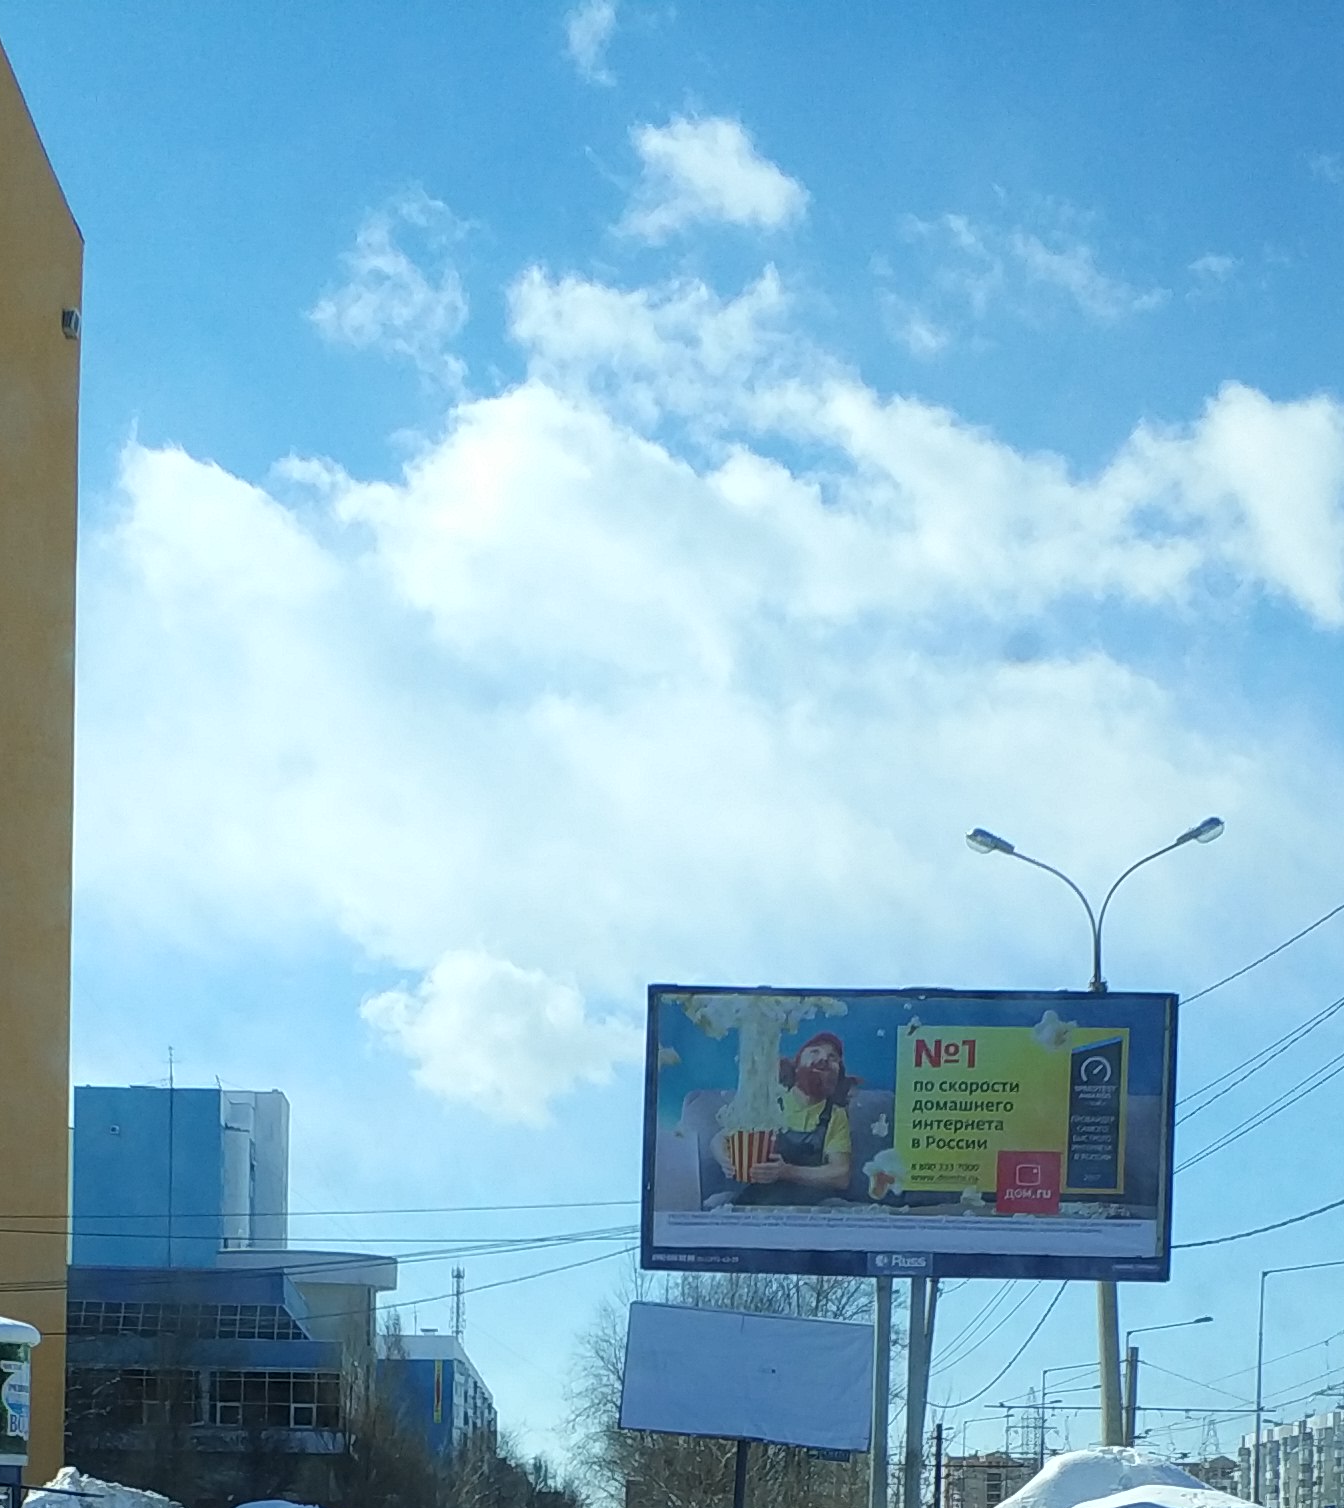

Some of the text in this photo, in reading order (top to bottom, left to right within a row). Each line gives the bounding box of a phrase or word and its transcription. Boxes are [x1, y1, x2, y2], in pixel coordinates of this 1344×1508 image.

[914, 1038, 977, 1068] №1
[913, 1080, 1020, 1096] по скорости
[912, 1100, 1015, 1114] домашнего
[912, 1119, 1004, 1134] интернета
[911, 1136, 988, 1150] в России
